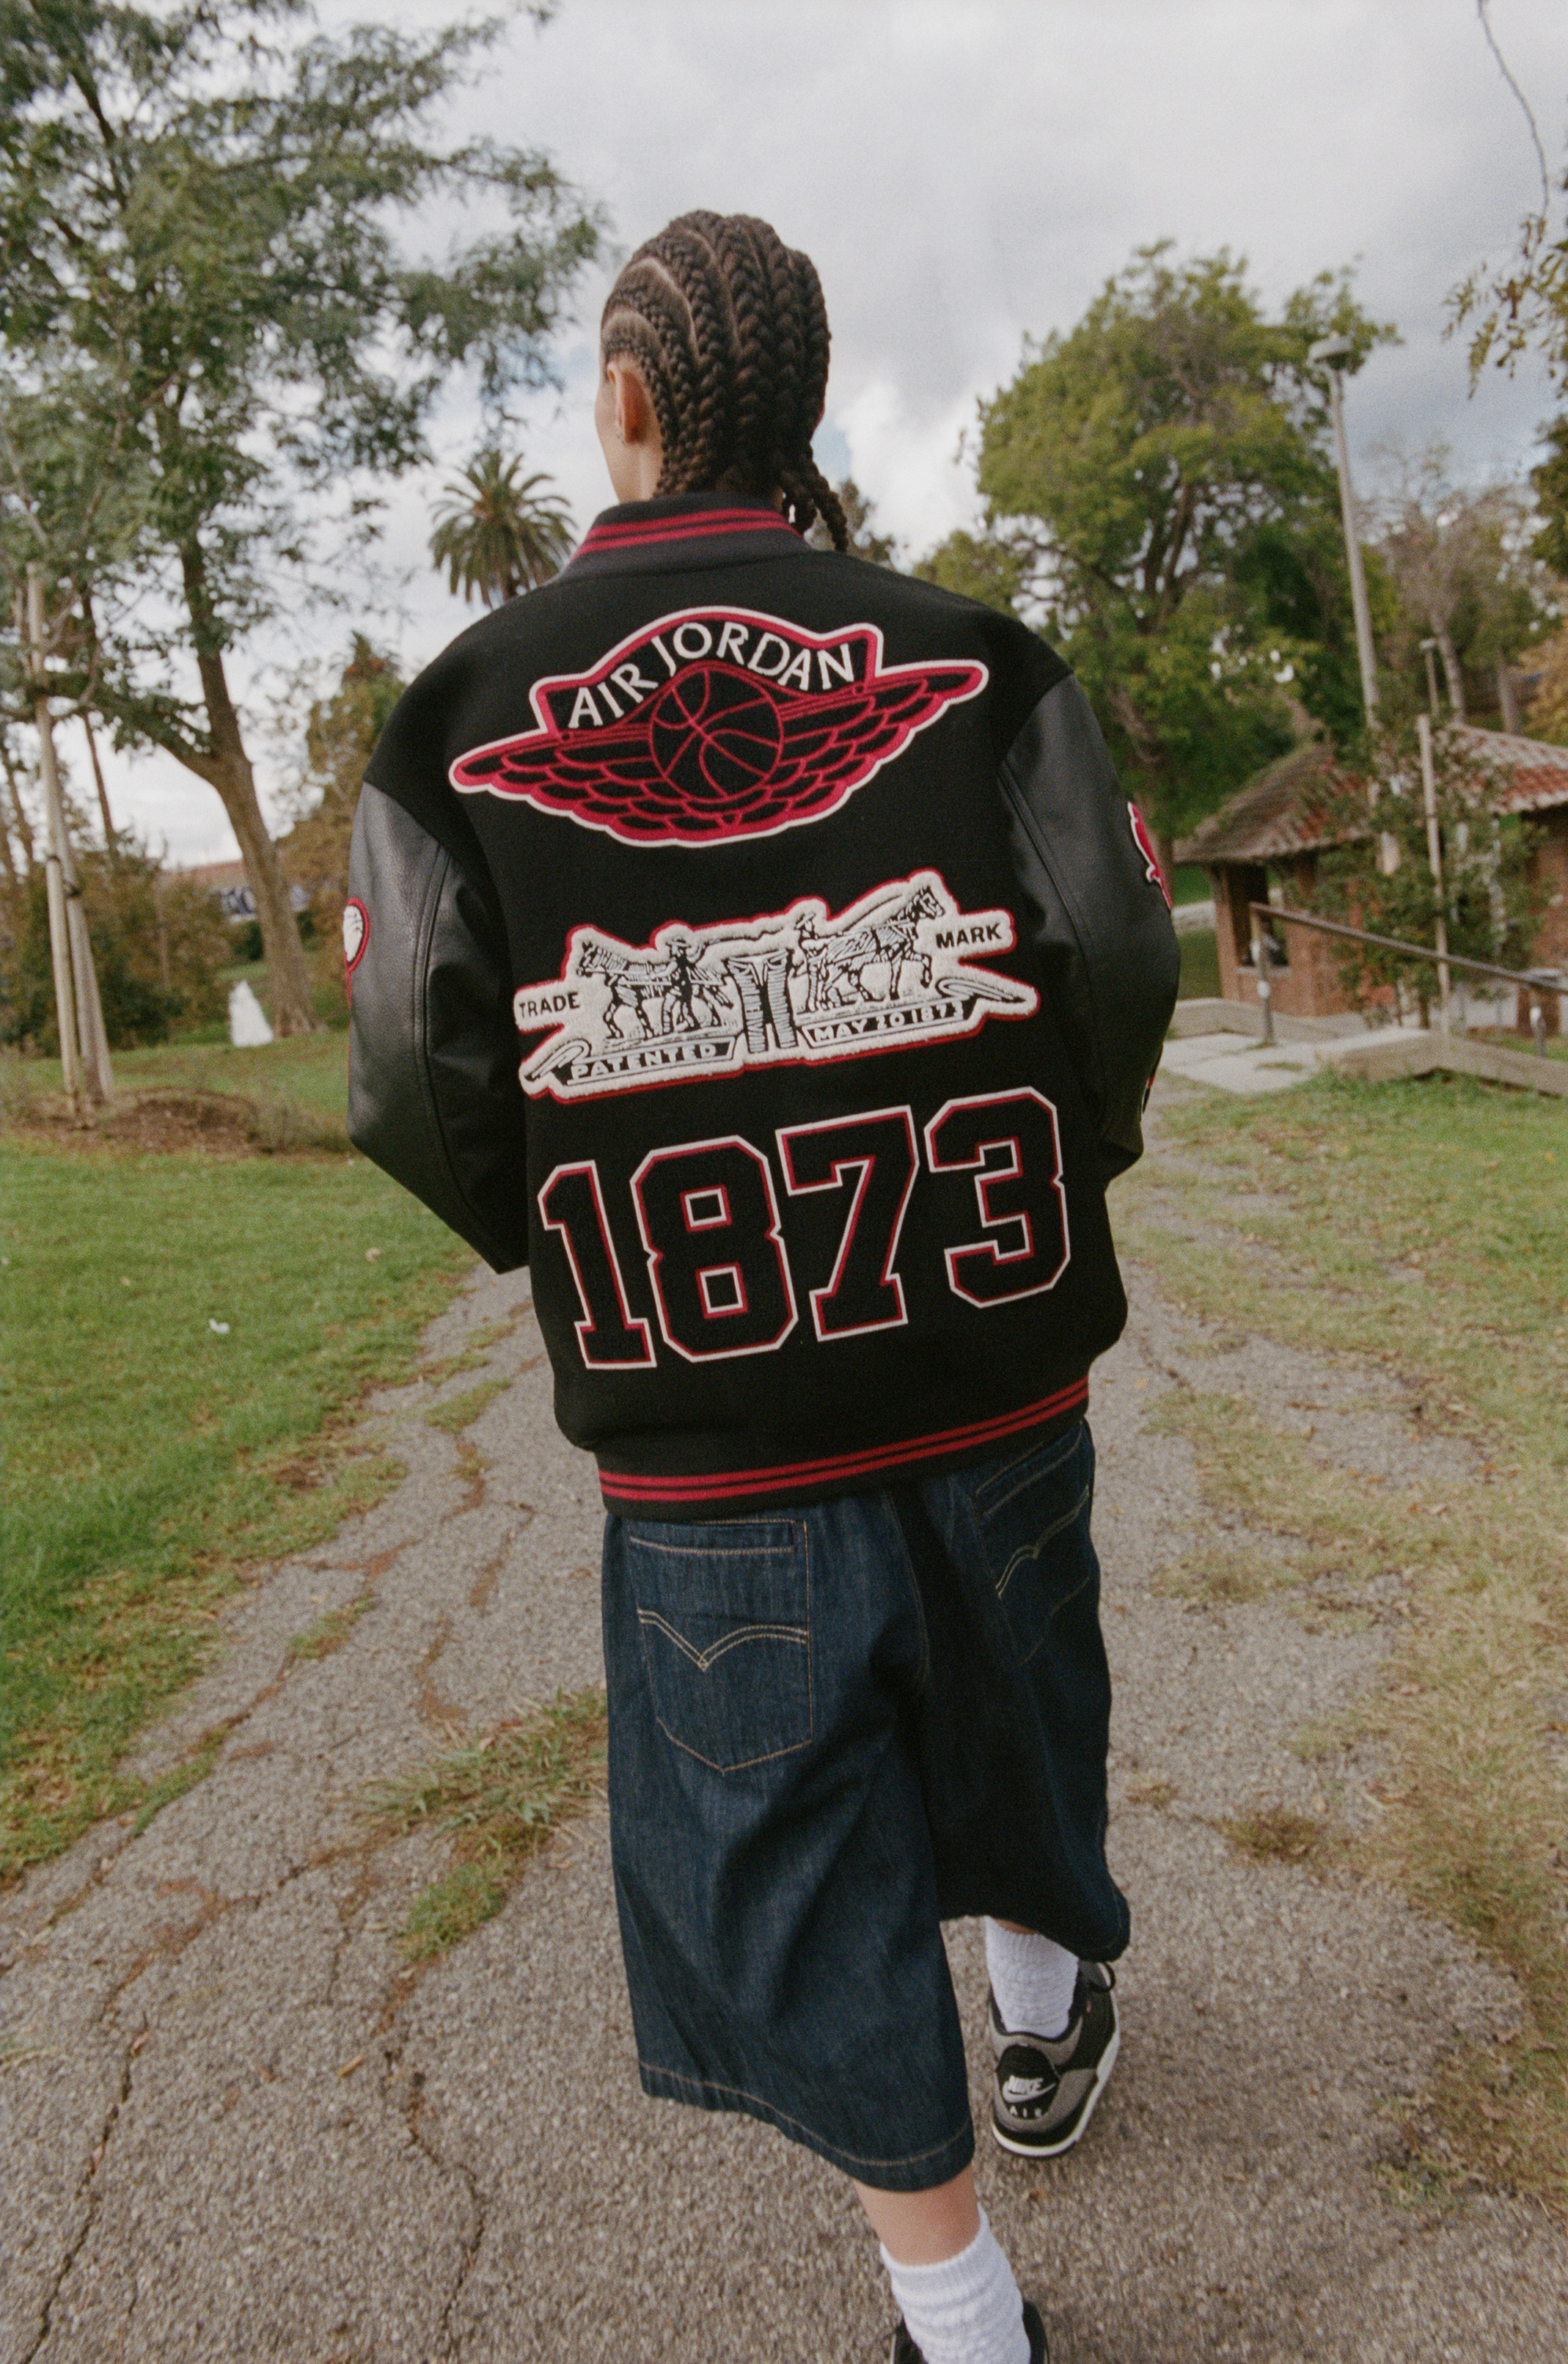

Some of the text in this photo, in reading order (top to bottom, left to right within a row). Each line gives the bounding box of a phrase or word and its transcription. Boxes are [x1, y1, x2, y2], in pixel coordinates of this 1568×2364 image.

[568, 621, 854, 728] AIR JORDAN
[519, 923, 1002, 1018] TRADE MARK
[571, 1000, 964, 1079] PATENTED MAY 20 1873
[537, 1086, 1071, 1369] 1873
[1007, 2075, 1044, 2095] NIKE
